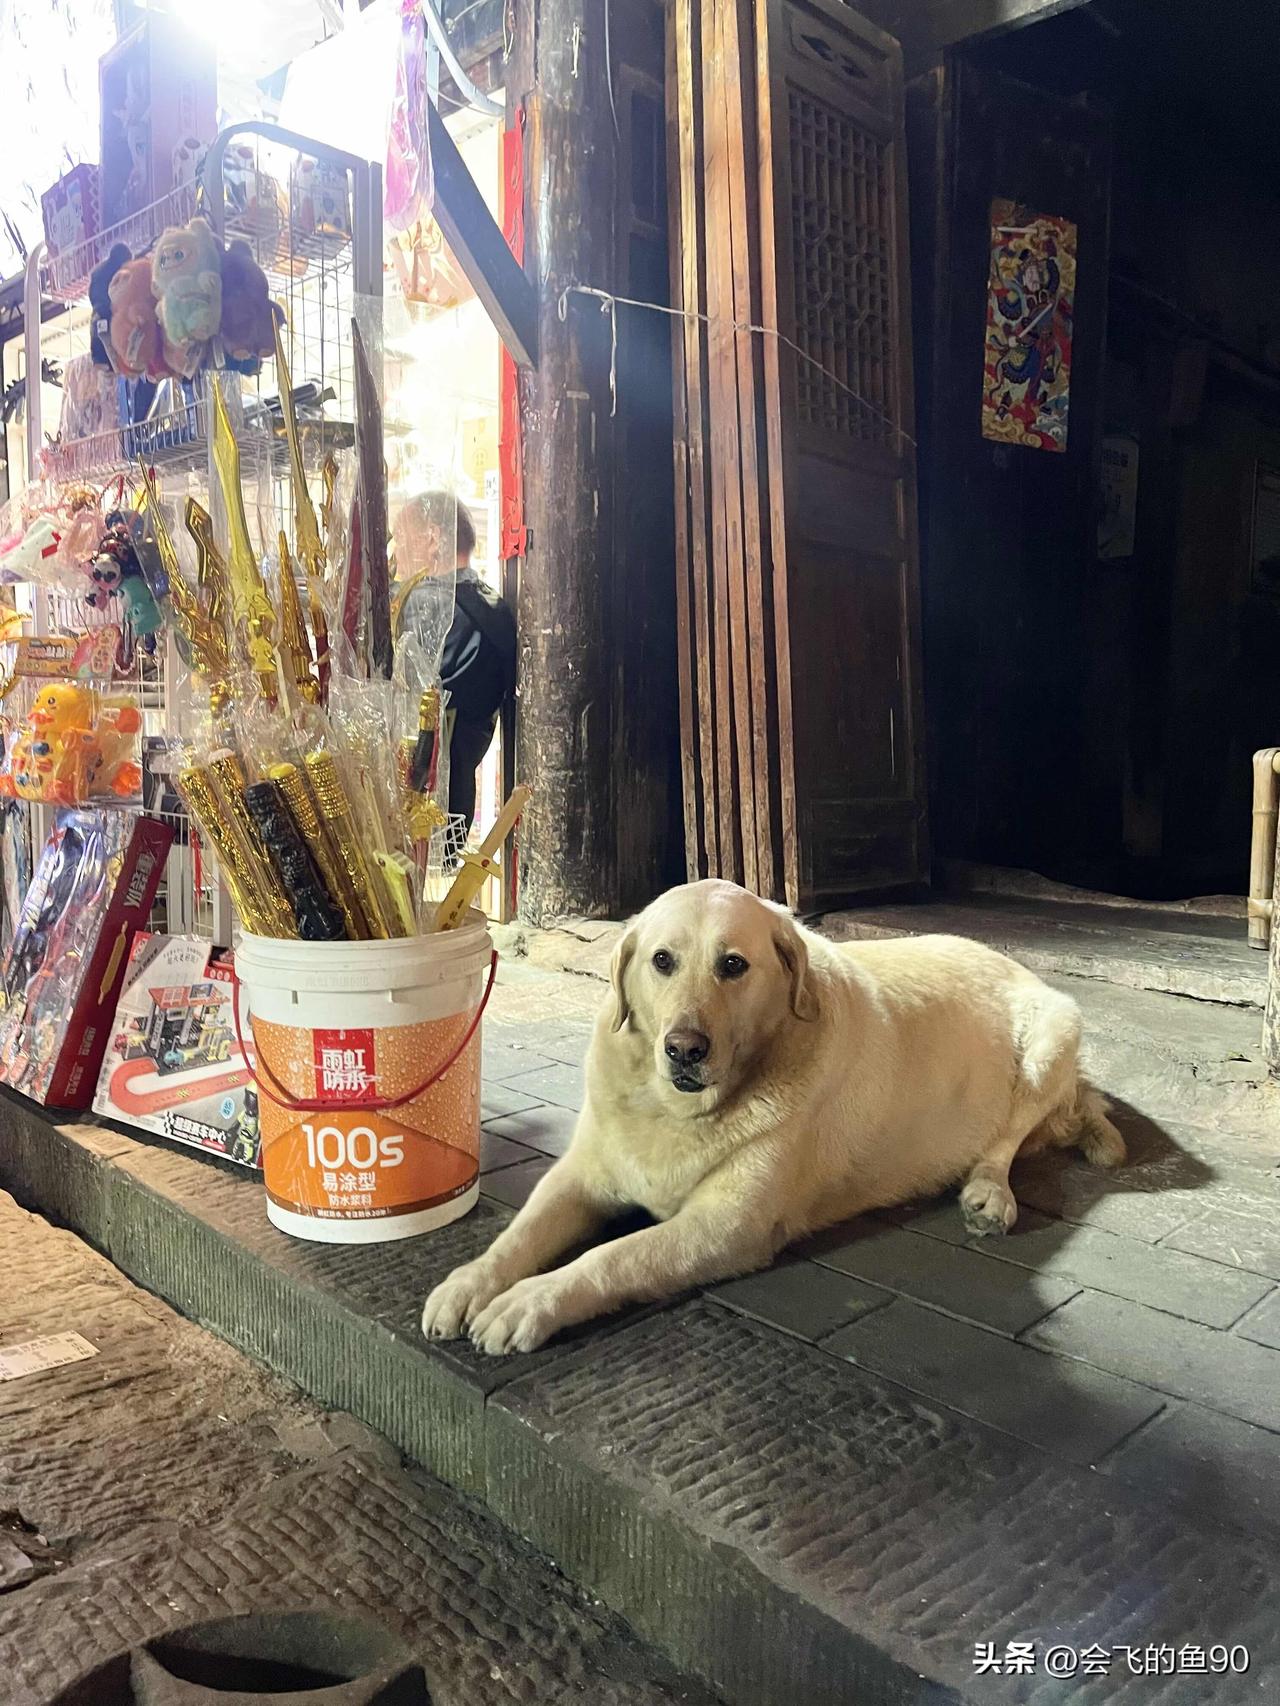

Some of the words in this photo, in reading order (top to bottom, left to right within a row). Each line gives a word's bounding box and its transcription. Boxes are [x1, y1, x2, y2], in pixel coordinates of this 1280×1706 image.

[321, 1048, 366, 1070] 雨虹
[301, 1123, 405, 1170] 100s
[322, 1170, 377, 1192] 易涂型
[328, 1194, 373, 1207] 防水浆料
